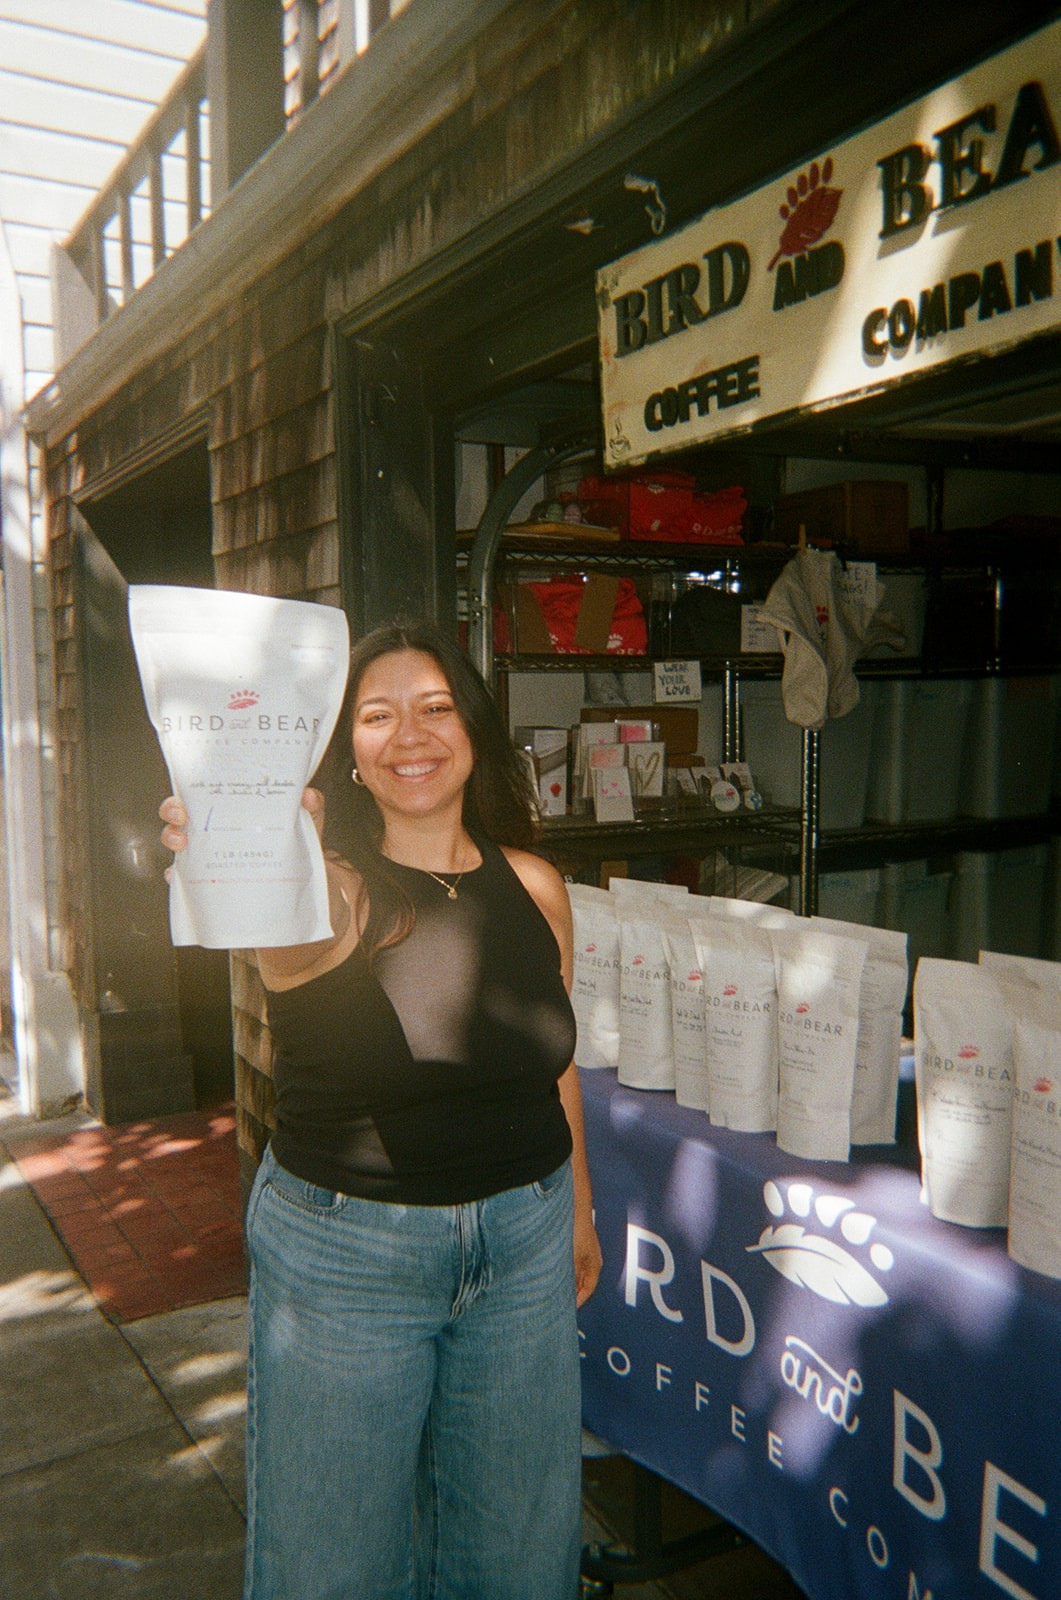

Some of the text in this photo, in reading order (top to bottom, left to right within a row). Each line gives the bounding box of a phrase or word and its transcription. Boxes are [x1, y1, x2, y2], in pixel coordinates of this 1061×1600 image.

[613, 80, 1061, 359] BIRD AND BEA
[643, 236, 1061, 434] COFFEE COMPAN
[663, 663, 688, 673] WEAR
[658, 674, 687, 686] YOUR
[665, 685, 691, 696] LOVE
[162, 714, 225, 733] BIRD
[733, 1000, 772, 1013] BEAR
[803, 1017, 843, 1037] BEAR
[592, 1209, 1048, 1600] RD and BE
